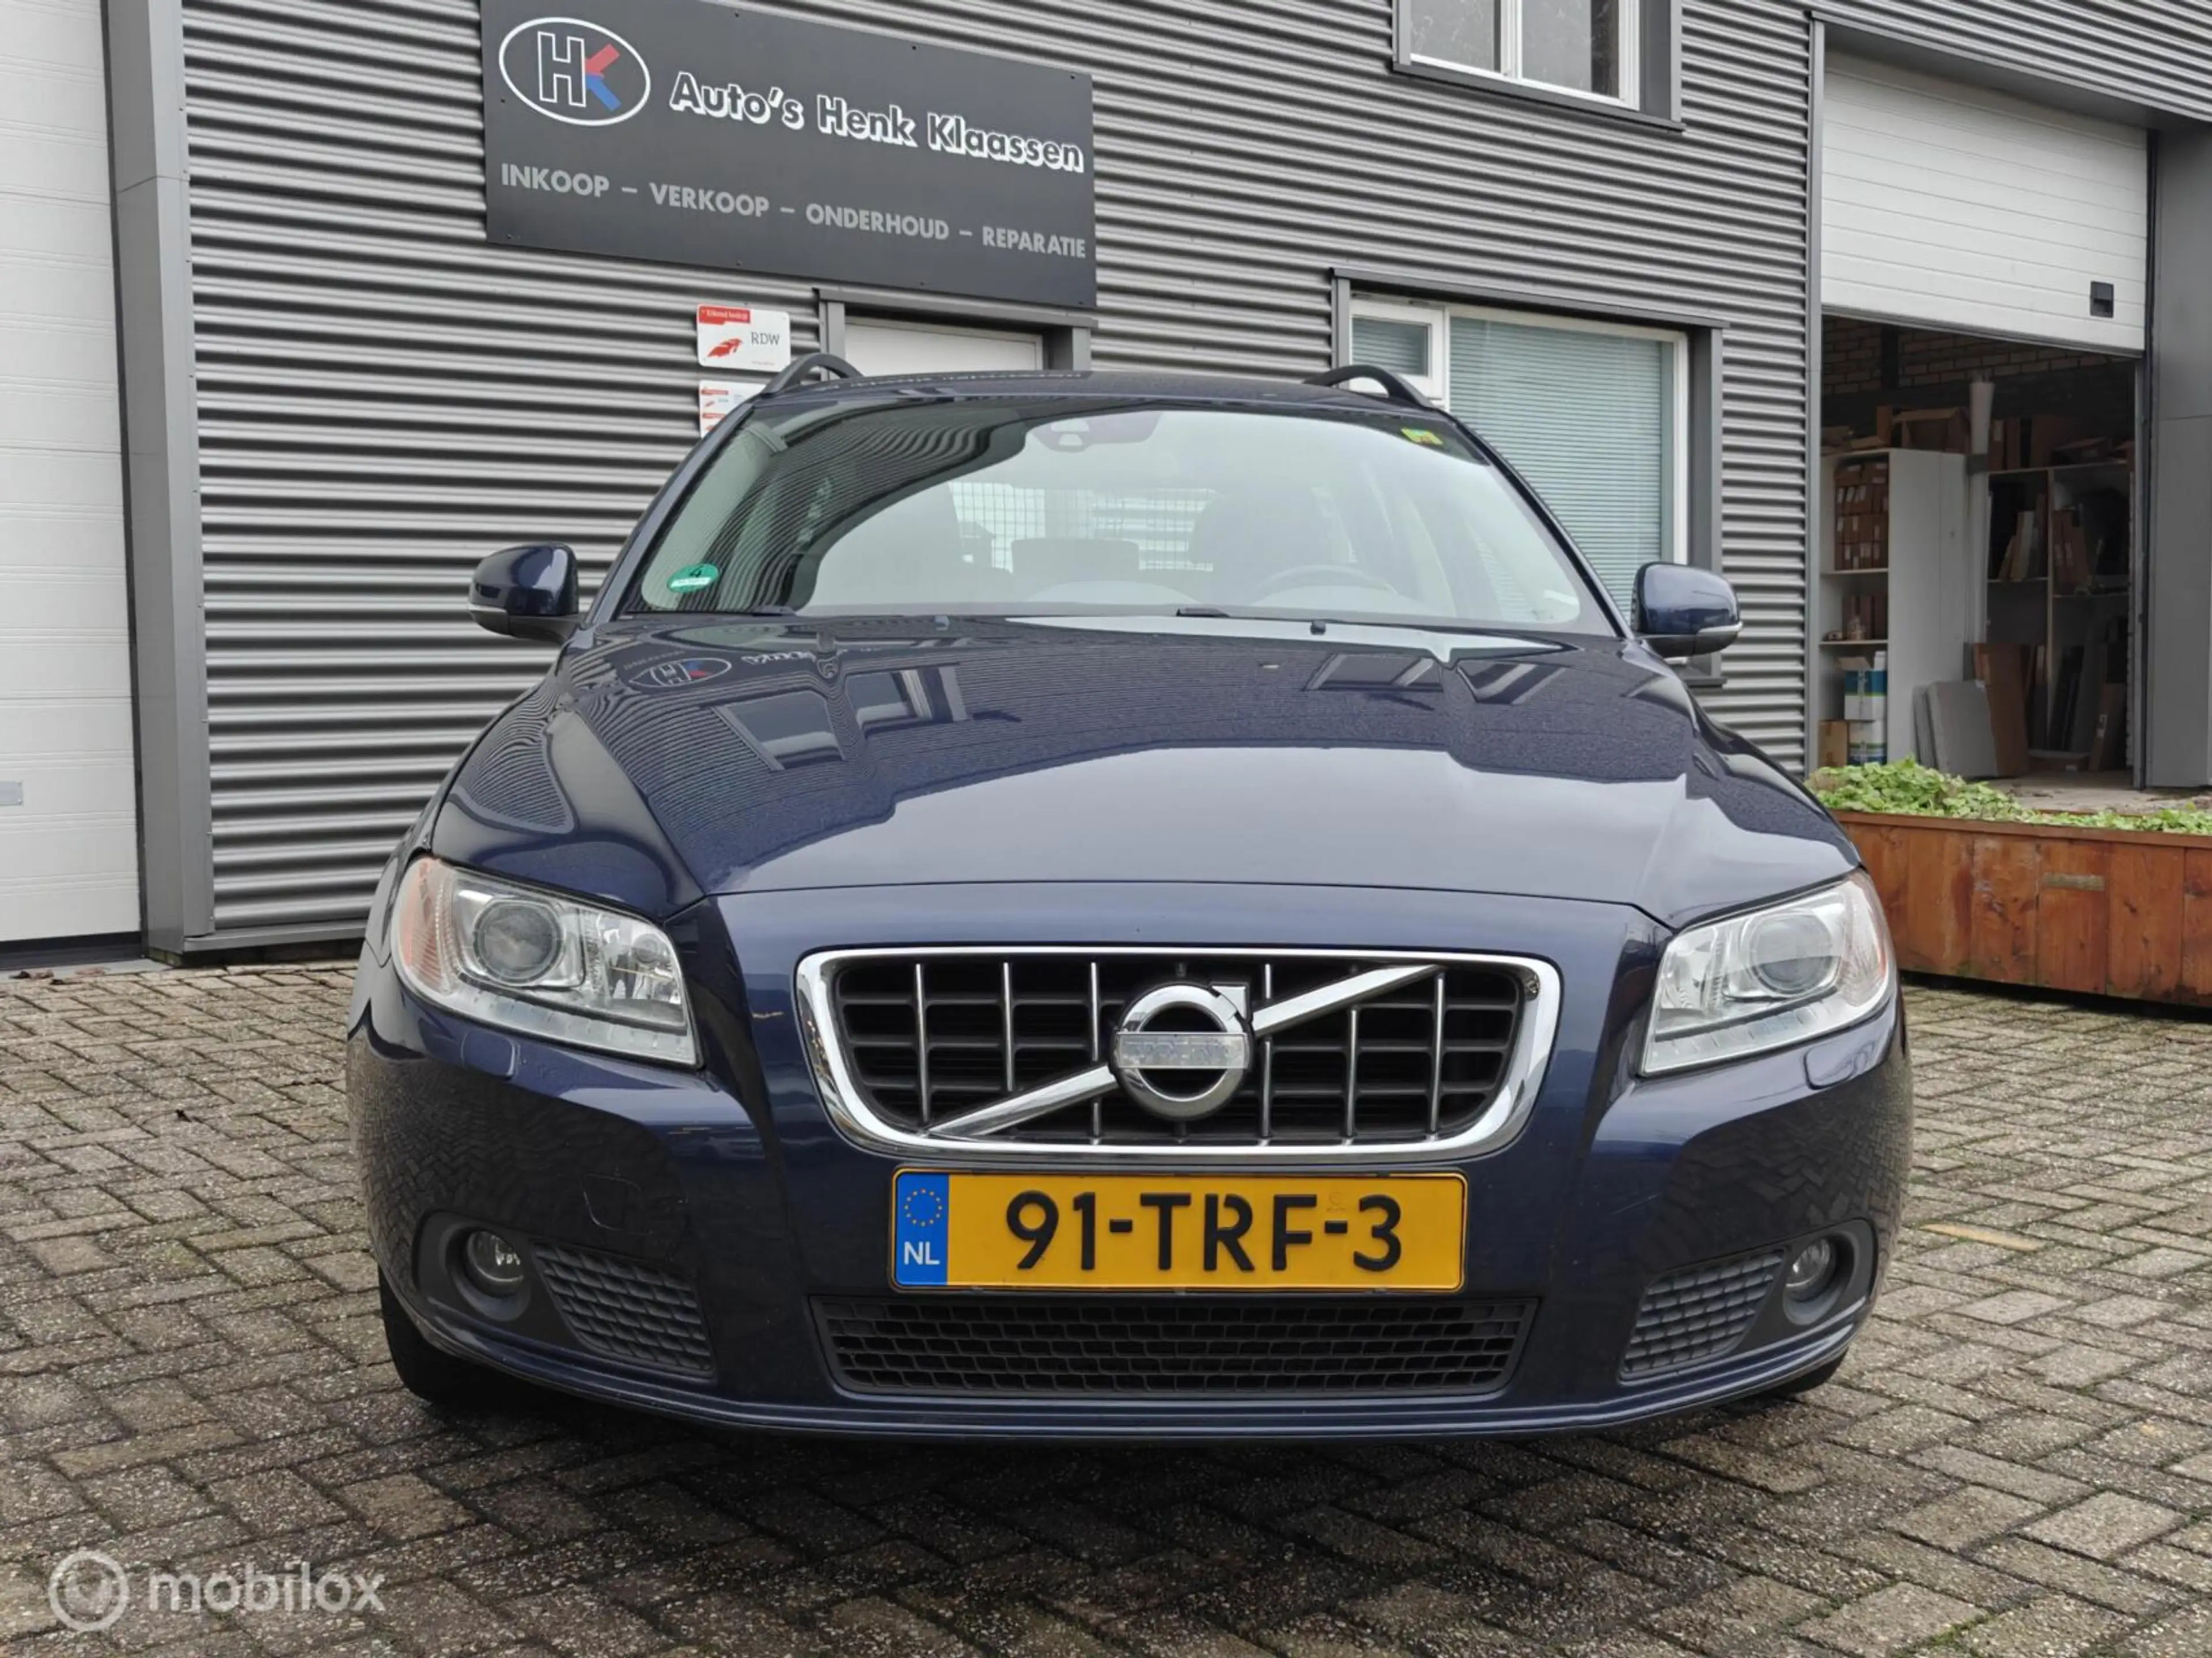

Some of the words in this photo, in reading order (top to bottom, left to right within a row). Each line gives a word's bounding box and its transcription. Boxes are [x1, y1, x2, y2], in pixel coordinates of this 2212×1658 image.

[537, 31, 622, 111] HK
[669, 71, 804, 130] Auto's
[817, 94, 919, 147] Henk
[927, 112, 1084, 173] Klaassen
[501, 163, 610, 198] INKOOP
[649, 181, 770, 217] VERKOOP
[805, 203, 949, 240] ONDERHOUD
[982, 226, 1086, 258] REPARATIE
[751, 332, 781, 346] RDW
[904, 1241, 940, 1266] NL
[1006, 1190, 1402, 1273] 91-TRF-3
